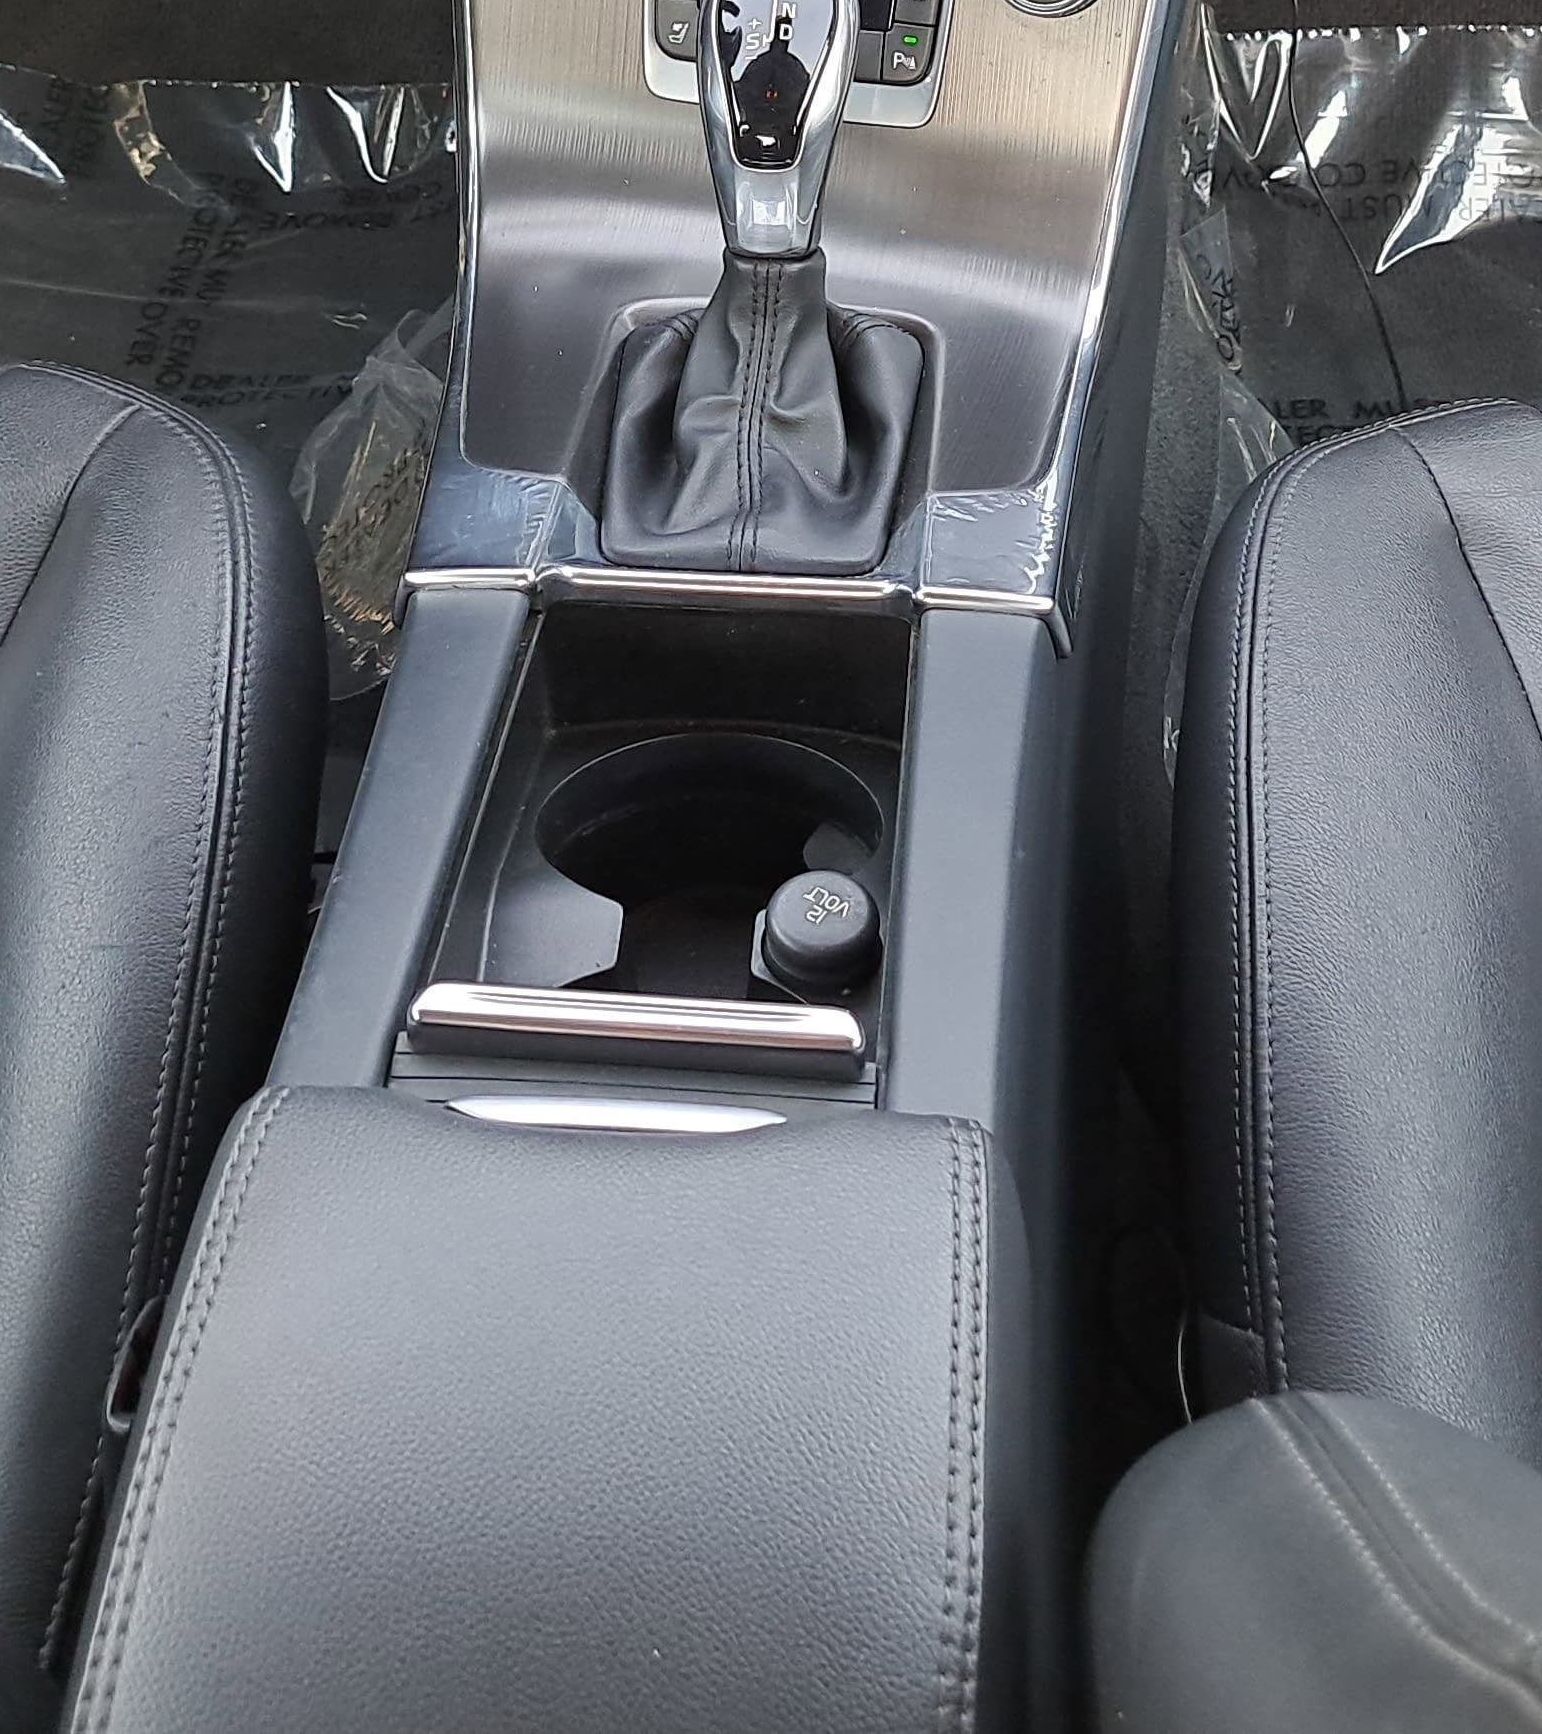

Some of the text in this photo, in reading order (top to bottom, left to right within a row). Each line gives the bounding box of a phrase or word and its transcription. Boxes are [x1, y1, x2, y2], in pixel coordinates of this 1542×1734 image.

[782, 2, 797, 18] N
[745, 23, 794, 51] S D
[802, 886, 851, 926] 12 VOLT
